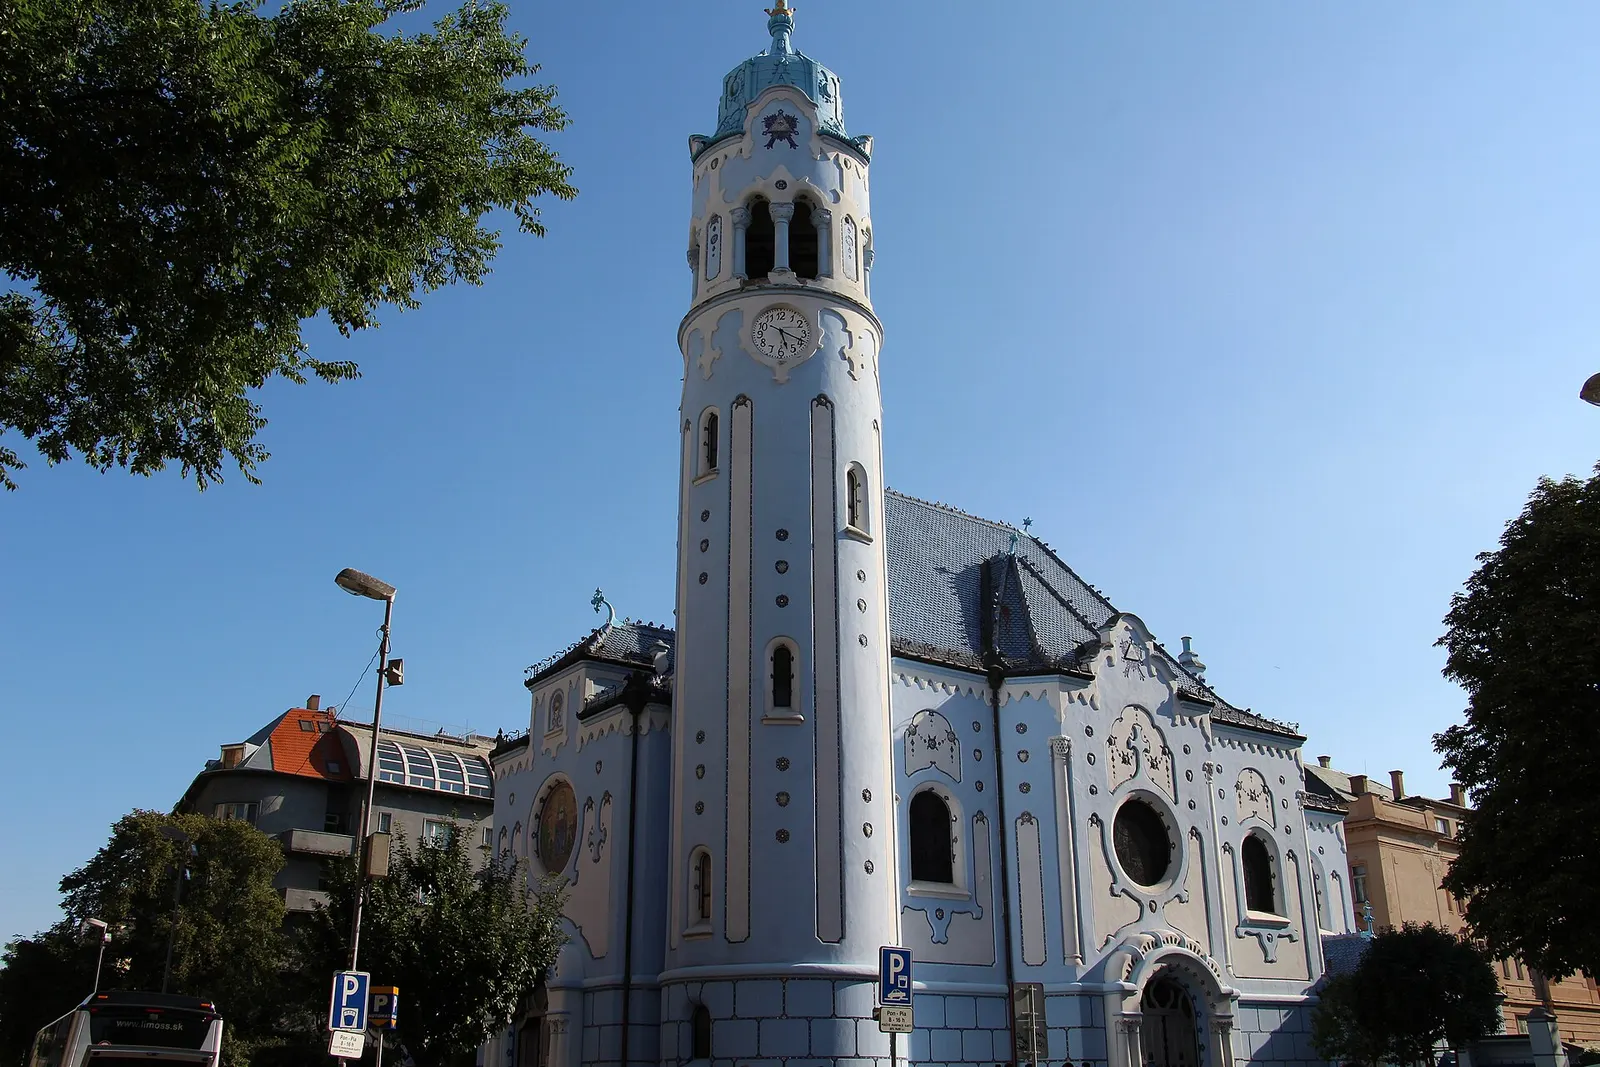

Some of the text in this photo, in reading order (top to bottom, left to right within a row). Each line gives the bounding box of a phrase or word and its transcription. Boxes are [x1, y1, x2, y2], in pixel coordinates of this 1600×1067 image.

[765, 314, 774, 323] 11
[776, 311, 786, 321] 12
[759, 322, 768, 331] 10
[796, 319, 803, 328] 2
[757, 330, 764, 339] 9
[801, 329, 807, 339] 3
[760, 338, 766, 347] 8
[797, 339, 804, 348] 4
[768, 344, 775, 353] 7
[777, 346, 785, 357] 6
[790, 344, 797, 353] 5
[889, 953, 904, 985] P
[342, 975, 359, 1007] P
[373, 994, 389, 1012] P
[116, 1020, 183, 1031] www.limoss.sk
